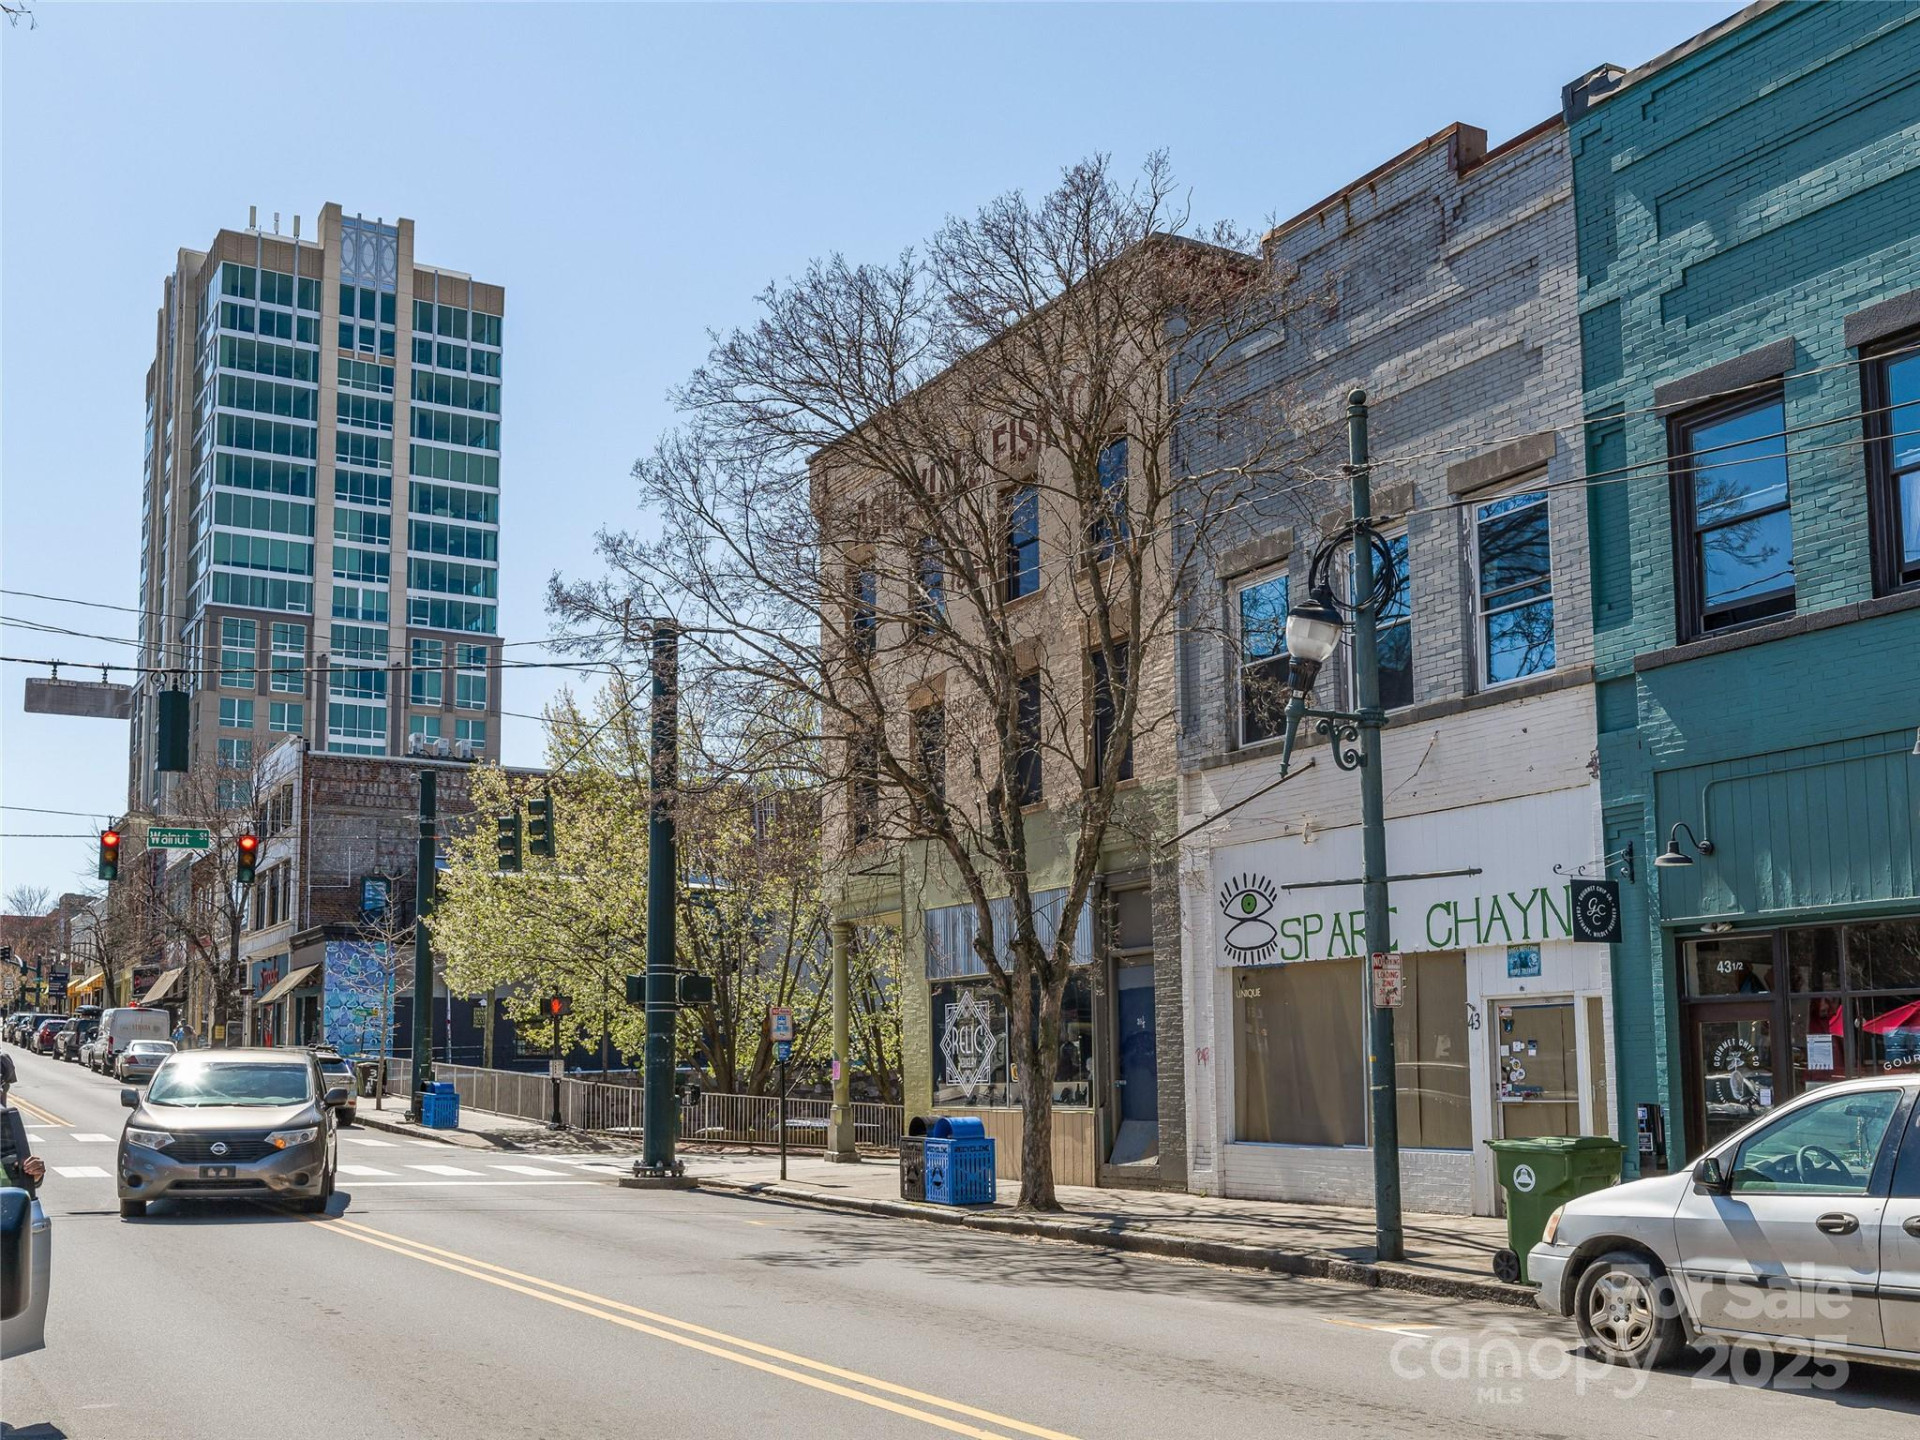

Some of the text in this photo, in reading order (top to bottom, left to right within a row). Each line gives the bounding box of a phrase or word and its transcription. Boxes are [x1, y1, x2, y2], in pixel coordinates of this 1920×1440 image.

[150, 831, 208, 845] Walnut St
[1373, 955, 1382, 967] NO
[1377, 971, 1399, 979] LOADING
[1235, 988, 1261, 998] UNIQUE
[1468, 1012, 1481, 1030] 43
[952, 1025, 983, 1054] RELIC
[1713, 1038, 1735, 1067] GOURMET
[1738, 1038, 1755, 1052] CHIP
